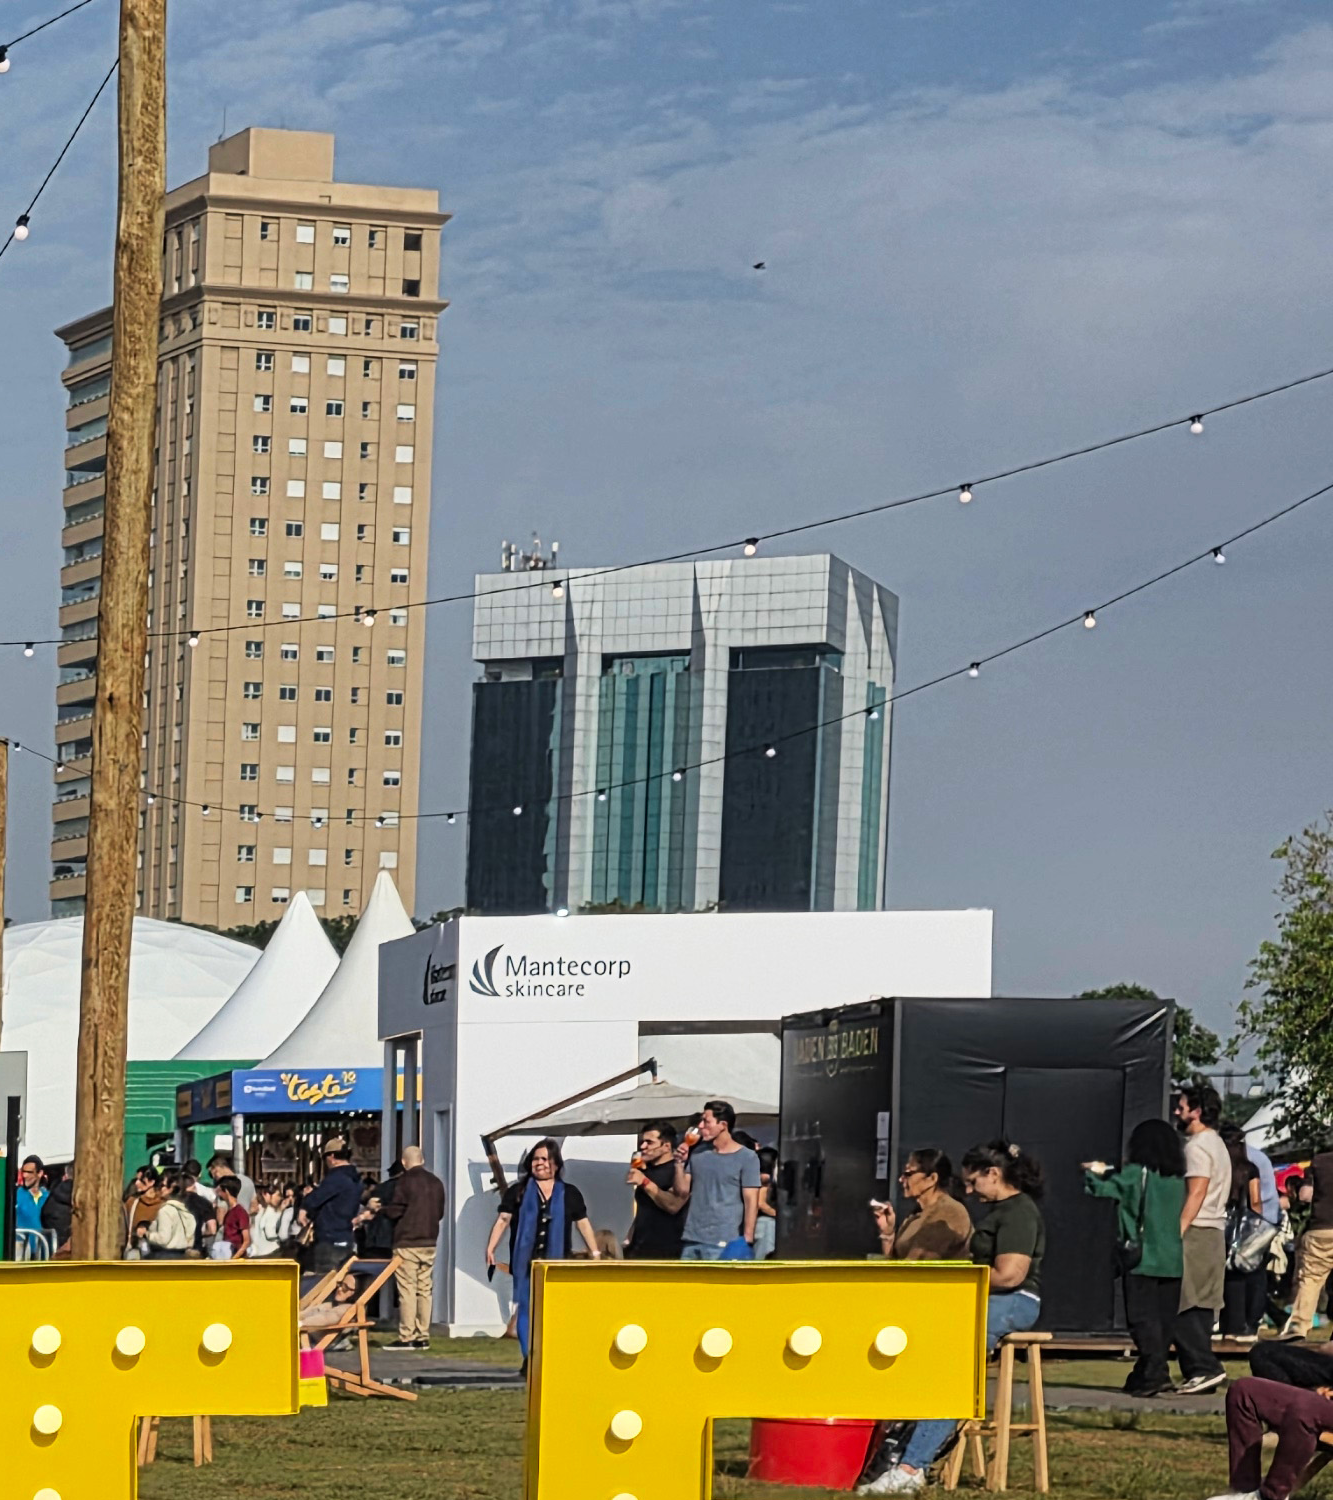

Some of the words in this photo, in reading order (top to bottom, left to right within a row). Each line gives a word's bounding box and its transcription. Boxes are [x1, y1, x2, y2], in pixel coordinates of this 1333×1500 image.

[505, 955, 631, 978] Mantecorp
[505, 980, 585, 998] skincare
[287, 1073, 353, 1105] taste
